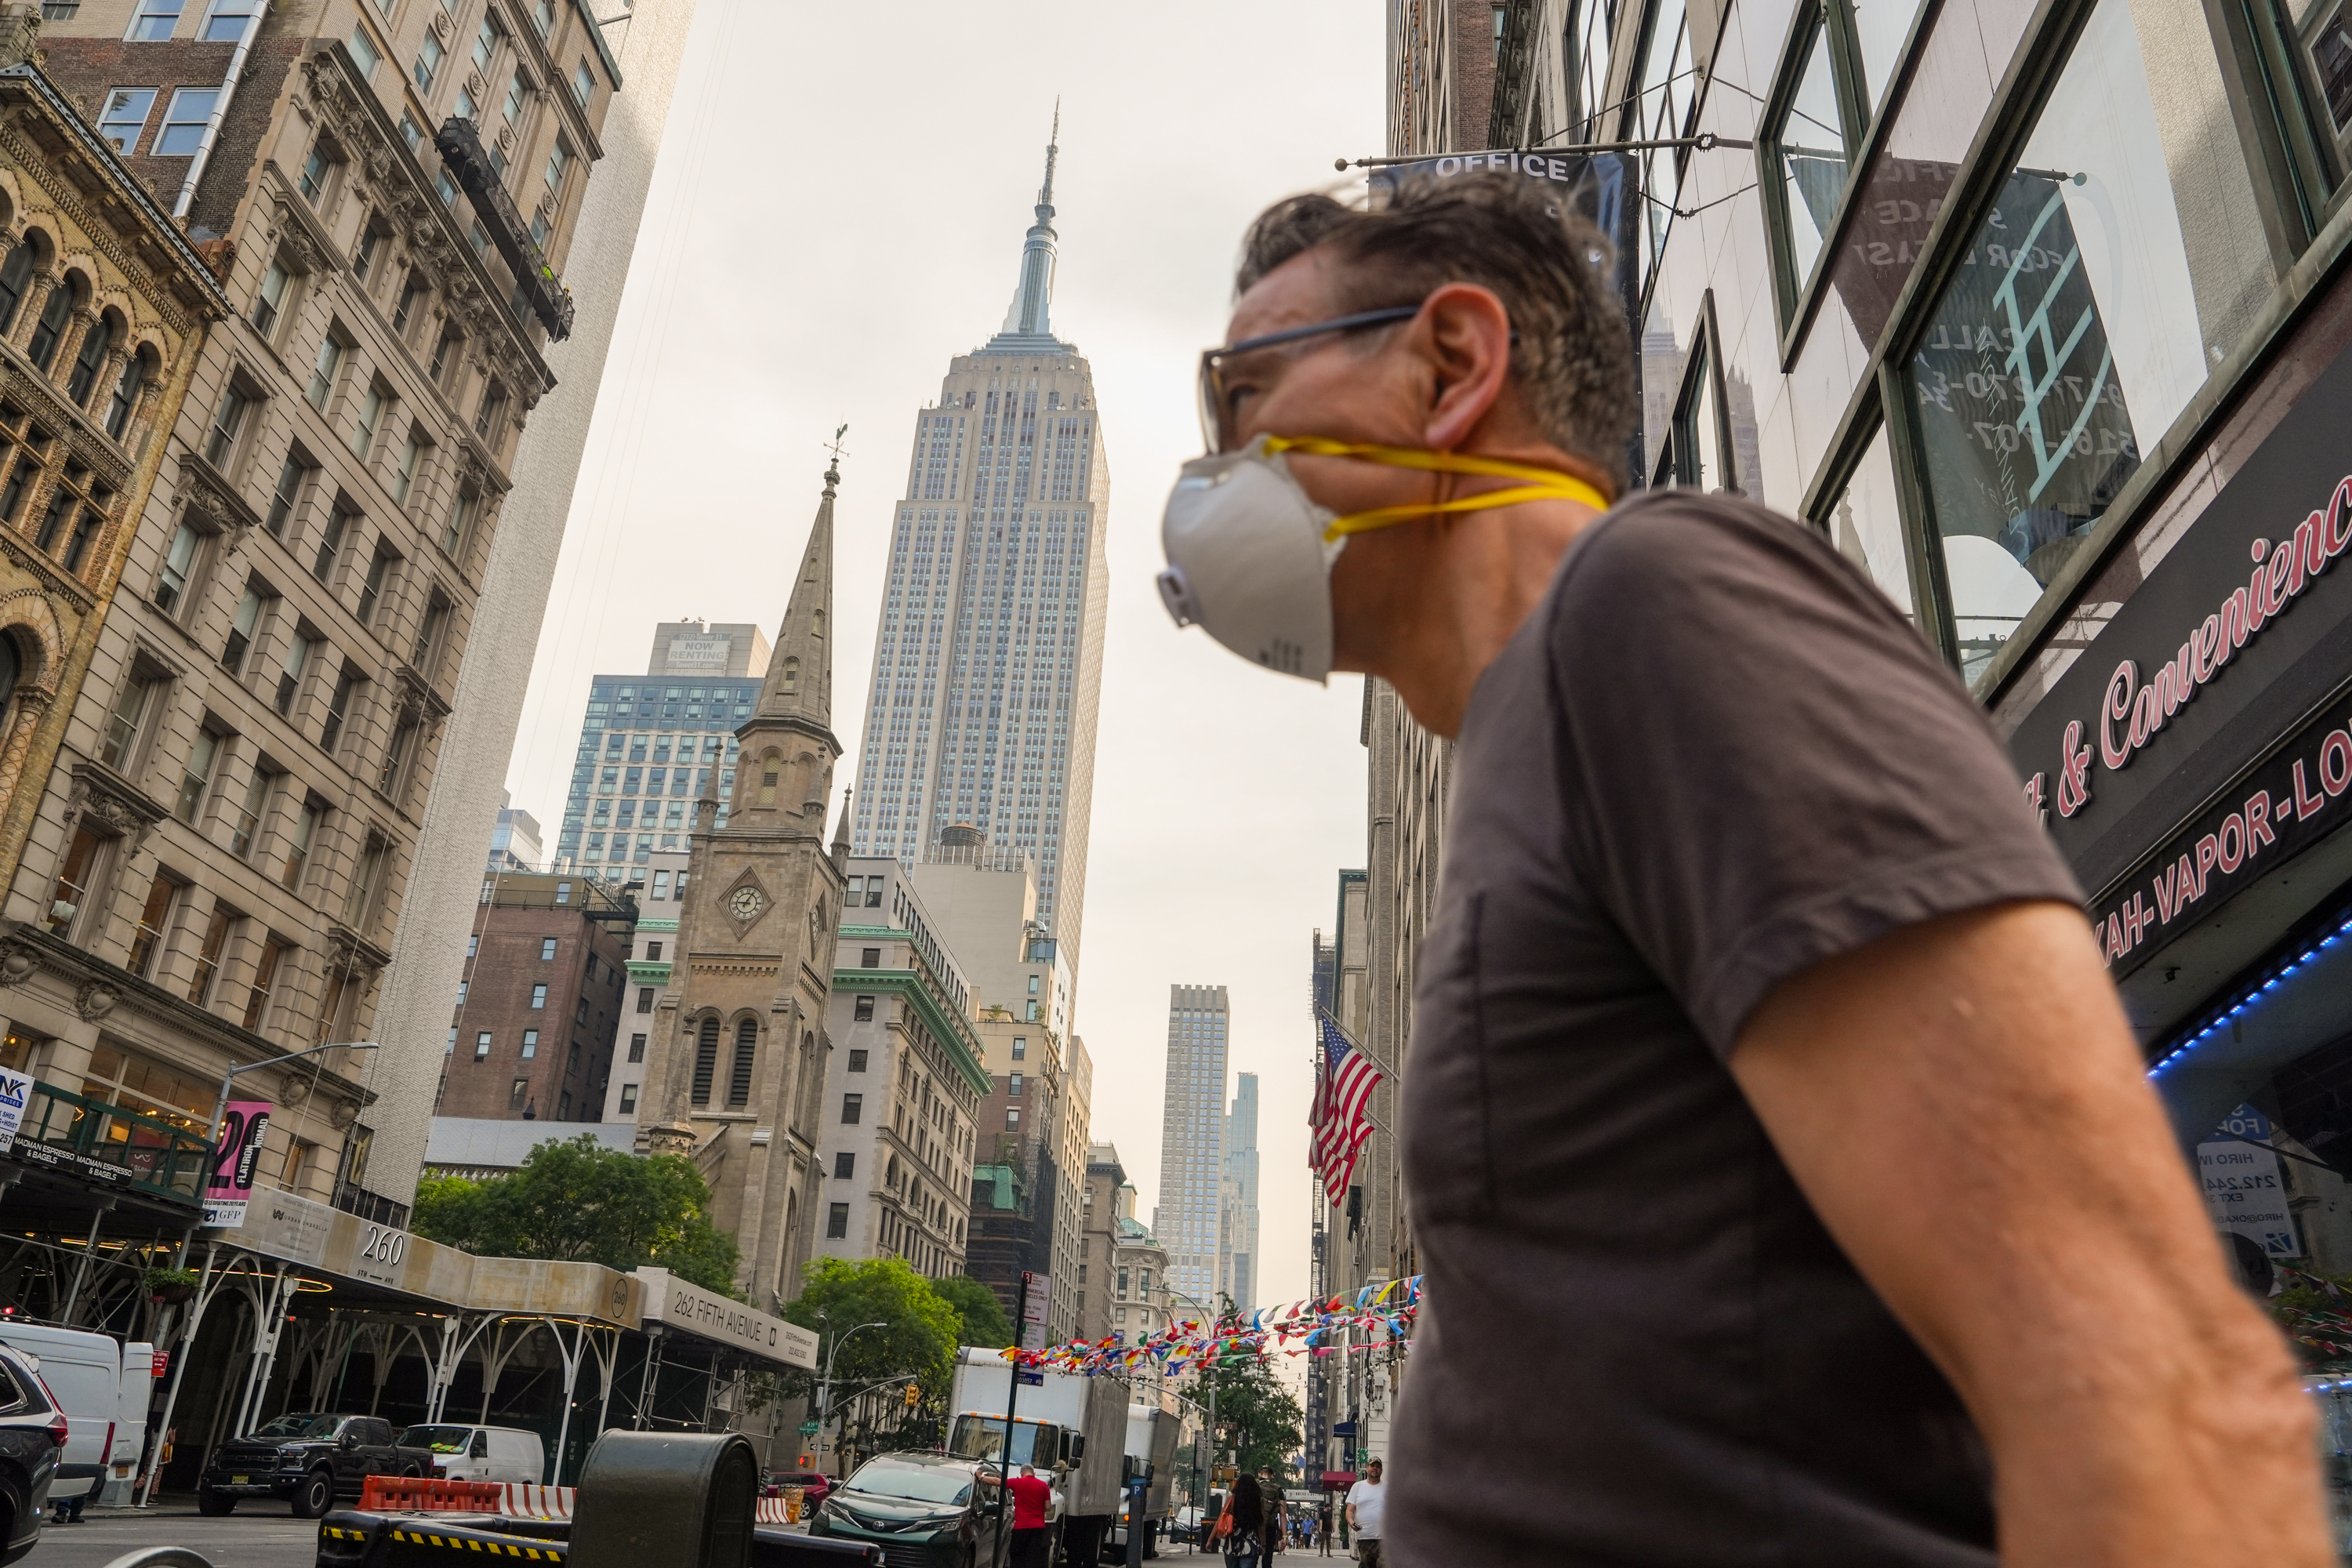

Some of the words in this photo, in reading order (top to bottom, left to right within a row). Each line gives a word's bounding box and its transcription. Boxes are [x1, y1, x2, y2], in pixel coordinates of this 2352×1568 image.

[1436, 153, 1569, 182] OFFICE
[670, 651, 724, 659] RENTING
[2058, 720, 2094, 818] &
[14, 1137, 42, 1151] MADMAN
[42, 1145, 75, 1160] ESPRESSO
[209, 1111, 270, 1190] 20
[237, 1145, 254, 1184] FLATIRON
[254, 1119, 269, 1148] NOMAD
[33, 1151, 58, 1164] BAGELS
[76, 1155, 103, 1169] MADMAN
[103, 1163, 132, 1177] ESPRESSO
[94, 1169, 118, 1181] BAGELS
[220, 1210, 241, 1219] GFP
[302, 1221, 328, 1232] UMBRELLA
[361, 1226, 404, 1266] 260
[358, 1269, 368, 1277] 5TH
[1025, 1272, 1030, 1283] 3
[614, 1290, 626, 1305] 260
[674, 1291, 695, 1318] 262
[696, 1299, 725, 1330] FIFTH
[726, 1311, 763, 1342] AVENUE
[1134, 1486, 1140, 1494] P
